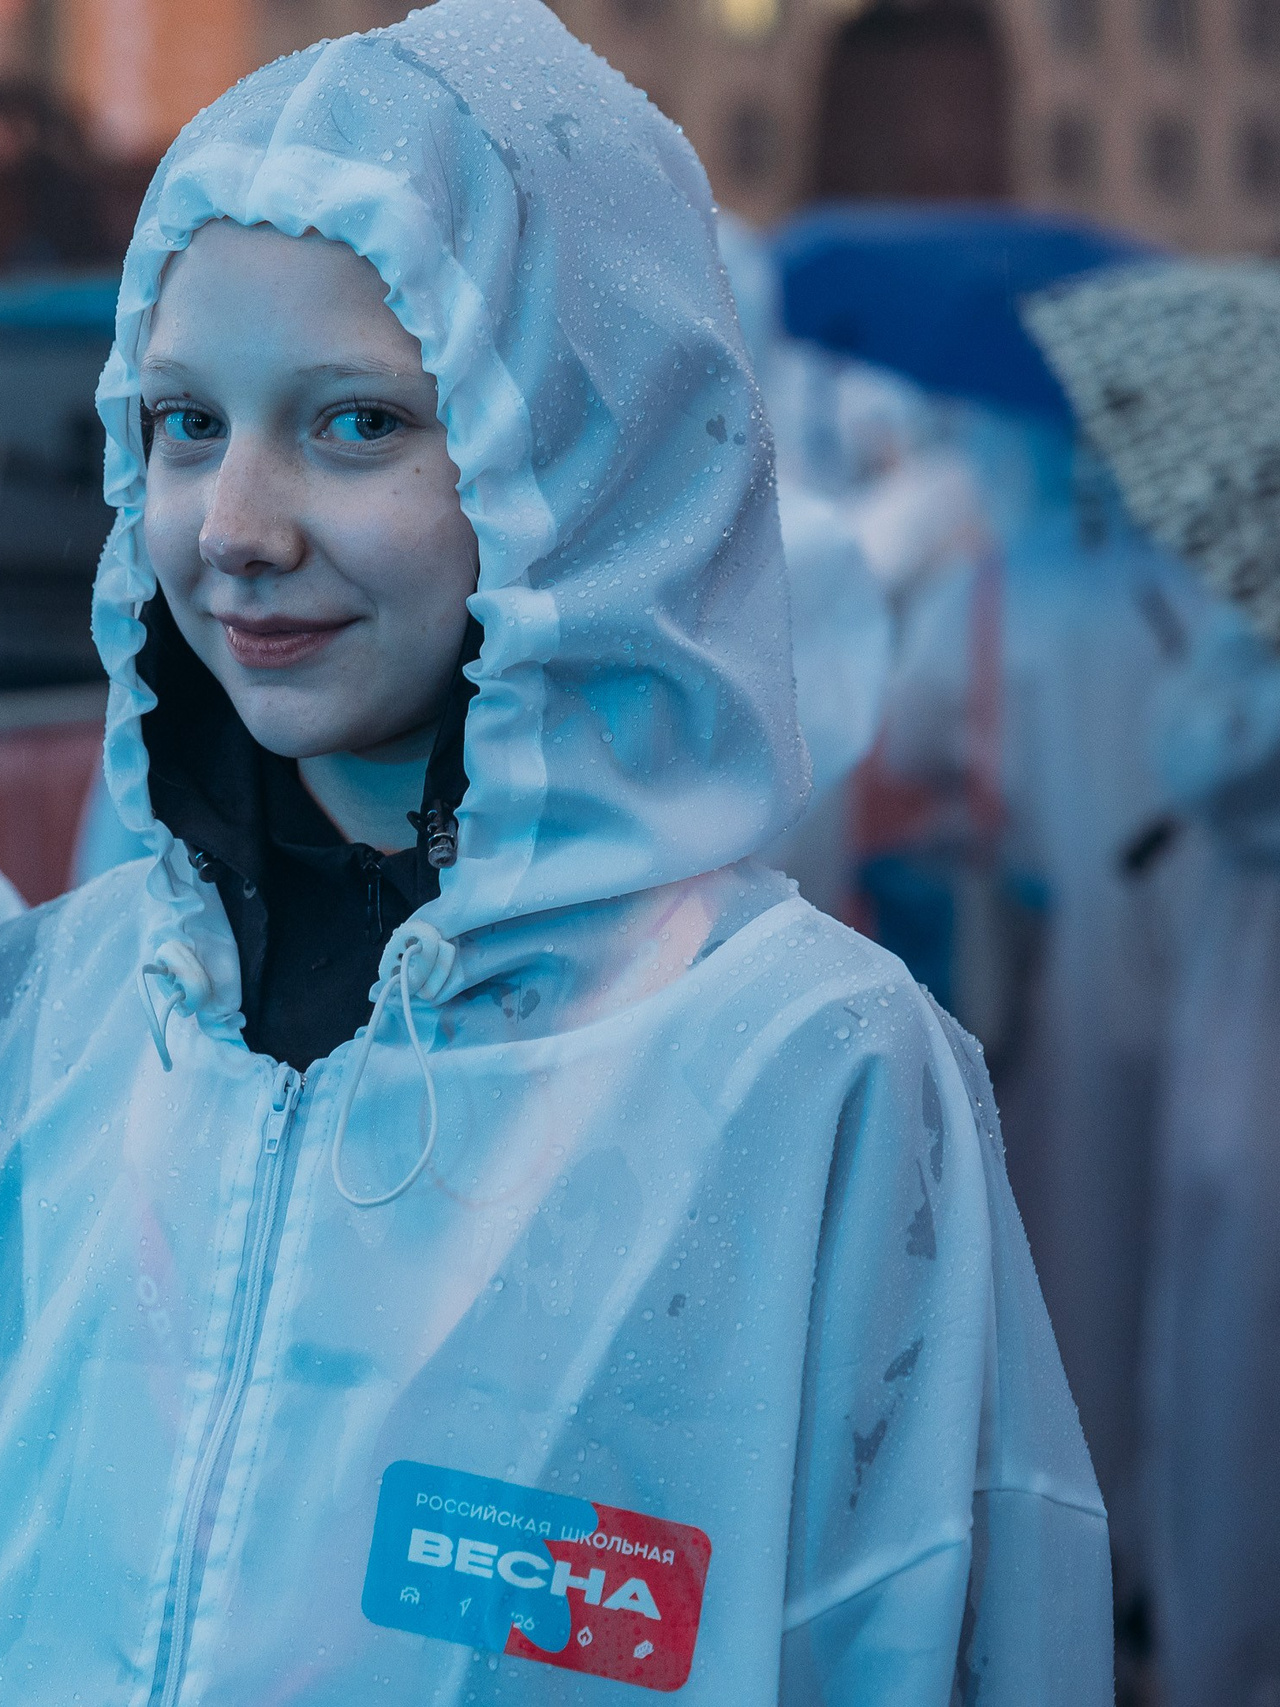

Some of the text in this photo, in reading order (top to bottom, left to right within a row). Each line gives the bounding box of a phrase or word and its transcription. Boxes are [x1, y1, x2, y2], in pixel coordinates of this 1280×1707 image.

[416, 1492, 676, 1566] РОССИЙСКАЯ ШКОЛЬНАЯ
[407, 1528, 662, 1621] ВЕСНА
